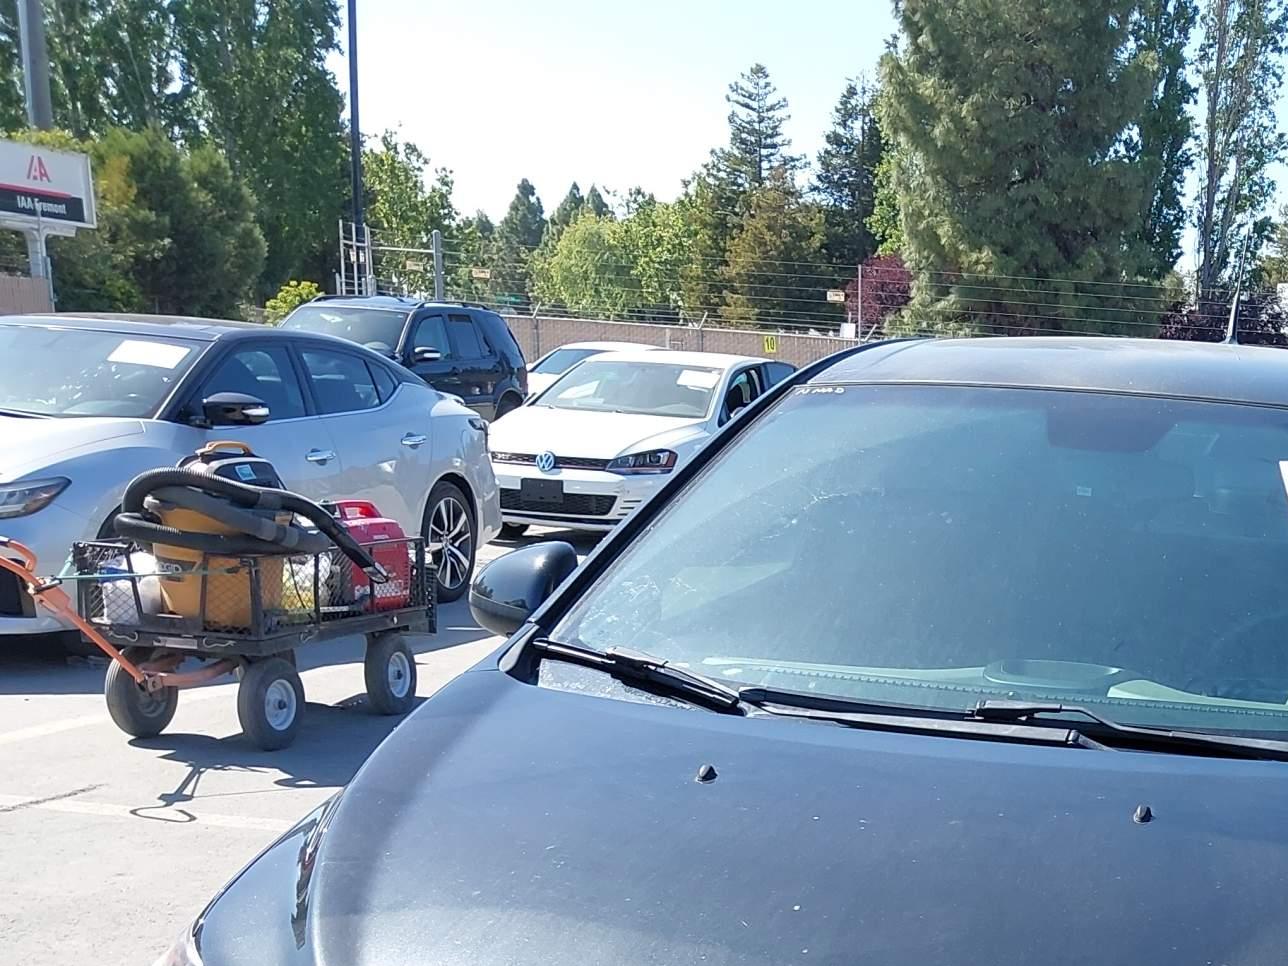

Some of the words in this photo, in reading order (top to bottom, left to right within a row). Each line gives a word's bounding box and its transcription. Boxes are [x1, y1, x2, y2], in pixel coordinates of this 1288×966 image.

[16, 195, 33, 210] IAA
[34, 198, 67, 214] Fremont
[765, 336, 775, 351] 10
